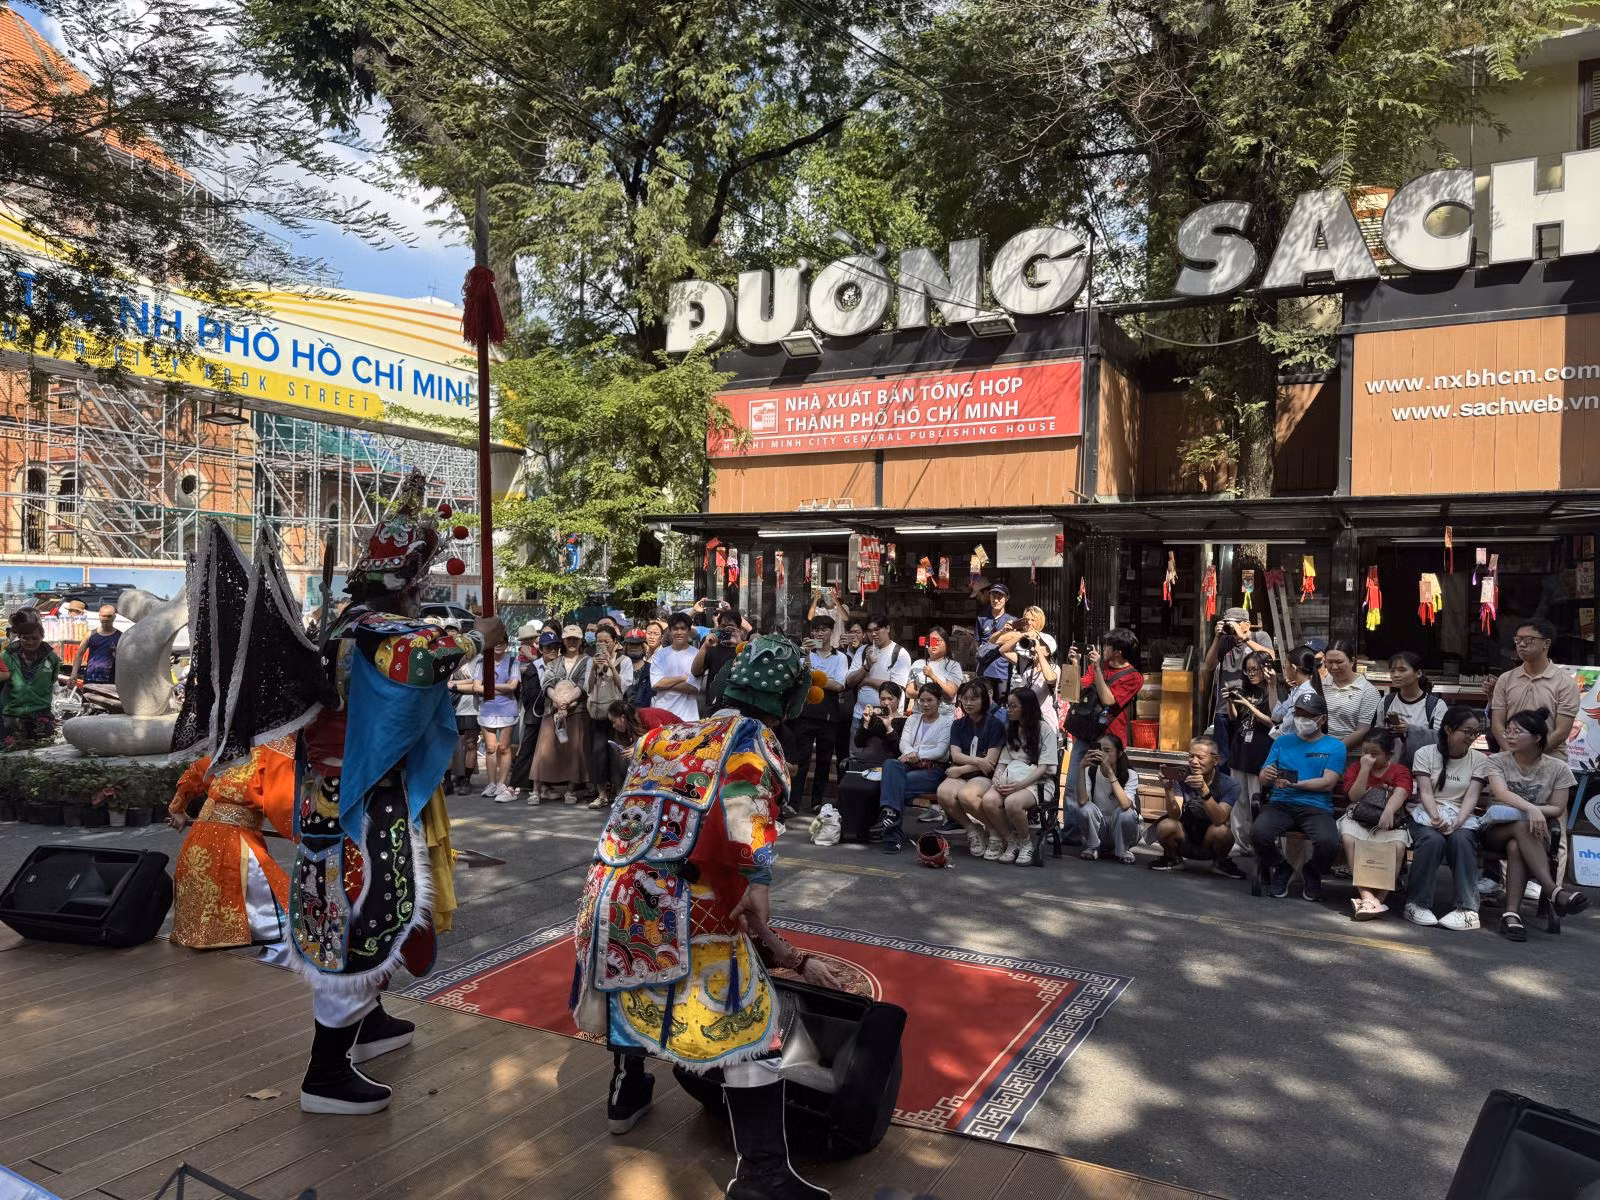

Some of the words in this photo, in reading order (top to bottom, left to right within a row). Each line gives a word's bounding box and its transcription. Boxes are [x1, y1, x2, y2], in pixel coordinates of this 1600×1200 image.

[664, 226, 1088, 352] ĐƯỜNG
[197, 314, 280, 363] PHỐ
[292, 337, 342, 377] HỒ
[351, 355, 405, 392] CHÍ
[205, 363, 267, 392] BOOK
[288, 380, 369, 411] STREET
[785, 393, 821, 412] NHÀ
[826, 388, 872, 410] XUẤT
[876, 384, 915, 406] BẢN
[979, 375, 1023, 398] HỢP
[1365, 364, 1600, 394] www.nxbhcm.com
[785, 412, 845, 432] THÀNH
[850, 407, 888, 428] PHỐ
[893, 404, 921, 425] HỒ
[926, 402, 959, 423] CHÍ
[964, 399, 1019, 420] MINH
[1391, 393, 1600, 422] www.sachweb.vn
[771, 439, 802, 449] MINH
[808, 436, 837, 446] CITY
[843, 432, 902, 444] GENERAL
[910, 425, 998, 440] PUBLISHING
[1006, 421, 1056, 433] HOUSE
